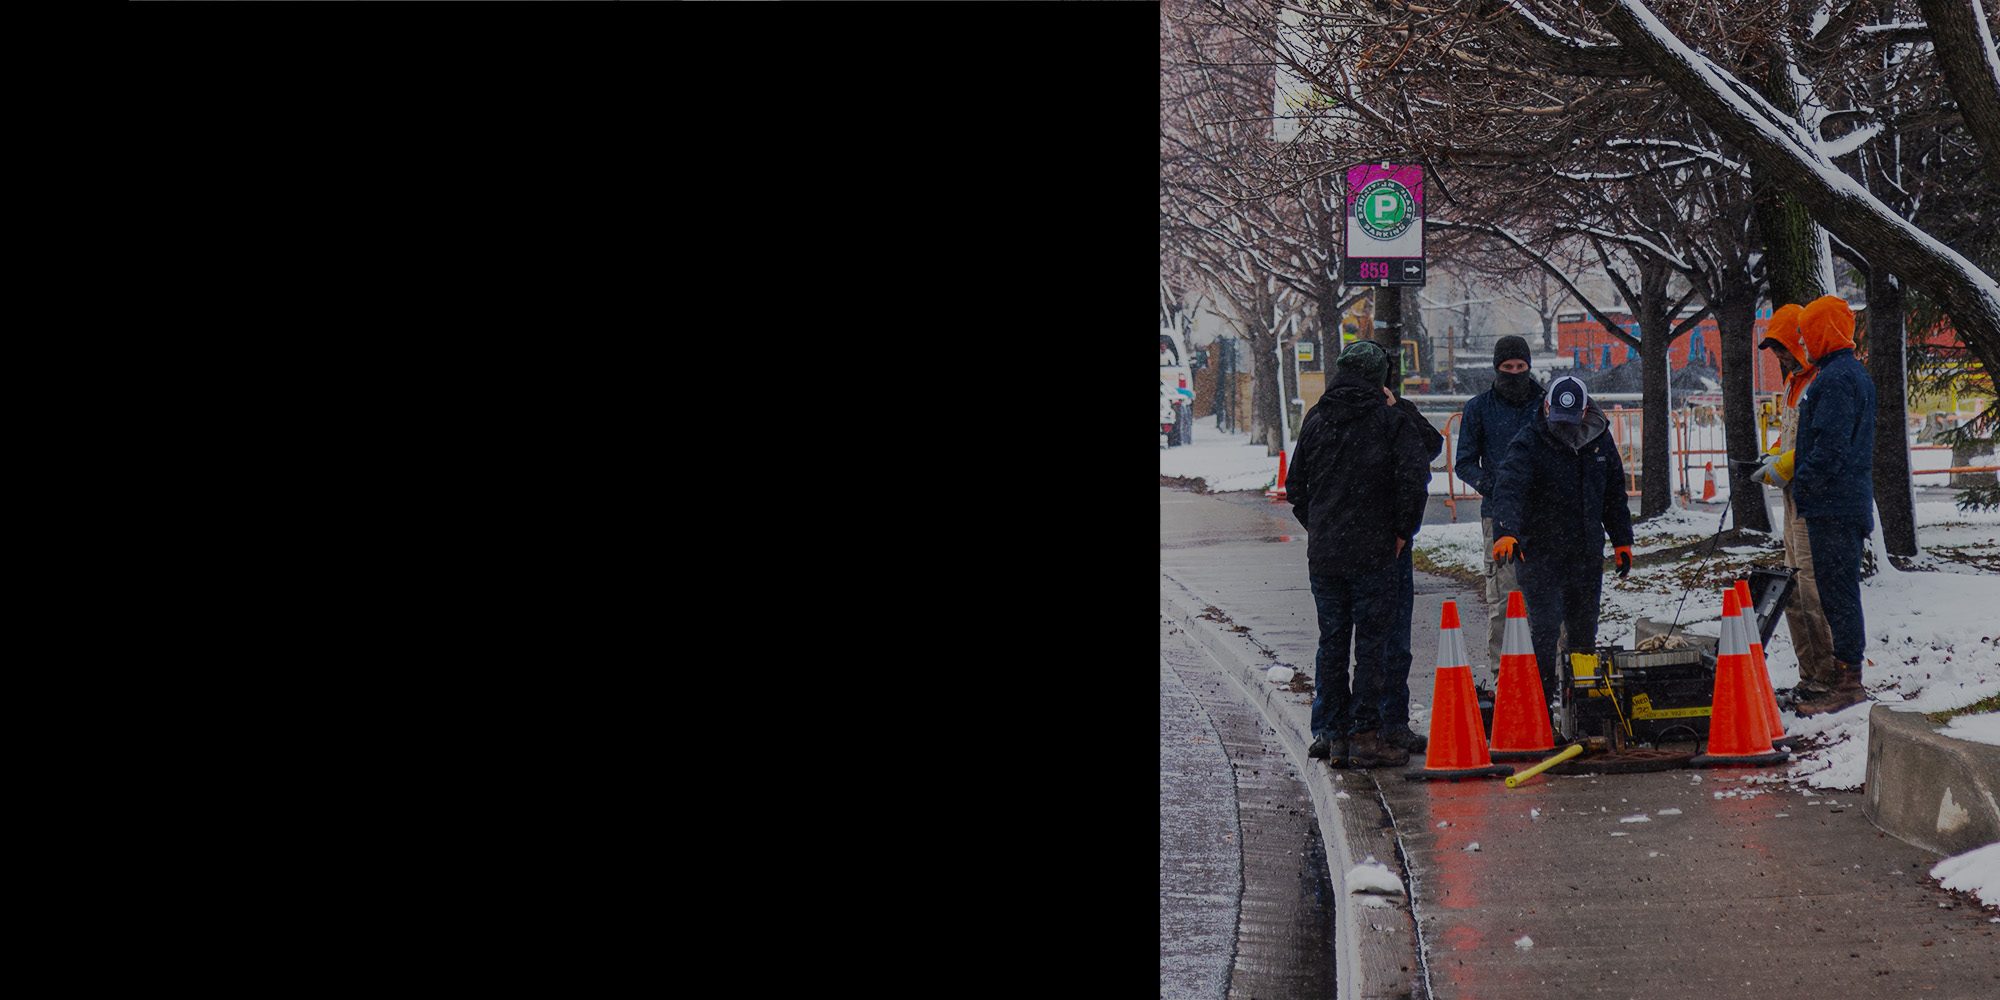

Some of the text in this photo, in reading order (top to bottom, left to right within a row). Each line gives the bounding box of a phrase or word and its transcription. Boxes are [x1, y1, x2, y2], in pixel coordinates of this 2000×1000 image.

[1375, 195, 1397, 218] P
[1364, 224, 1406, 237] PARKING
[1360, 262, 1389, 279] 859
